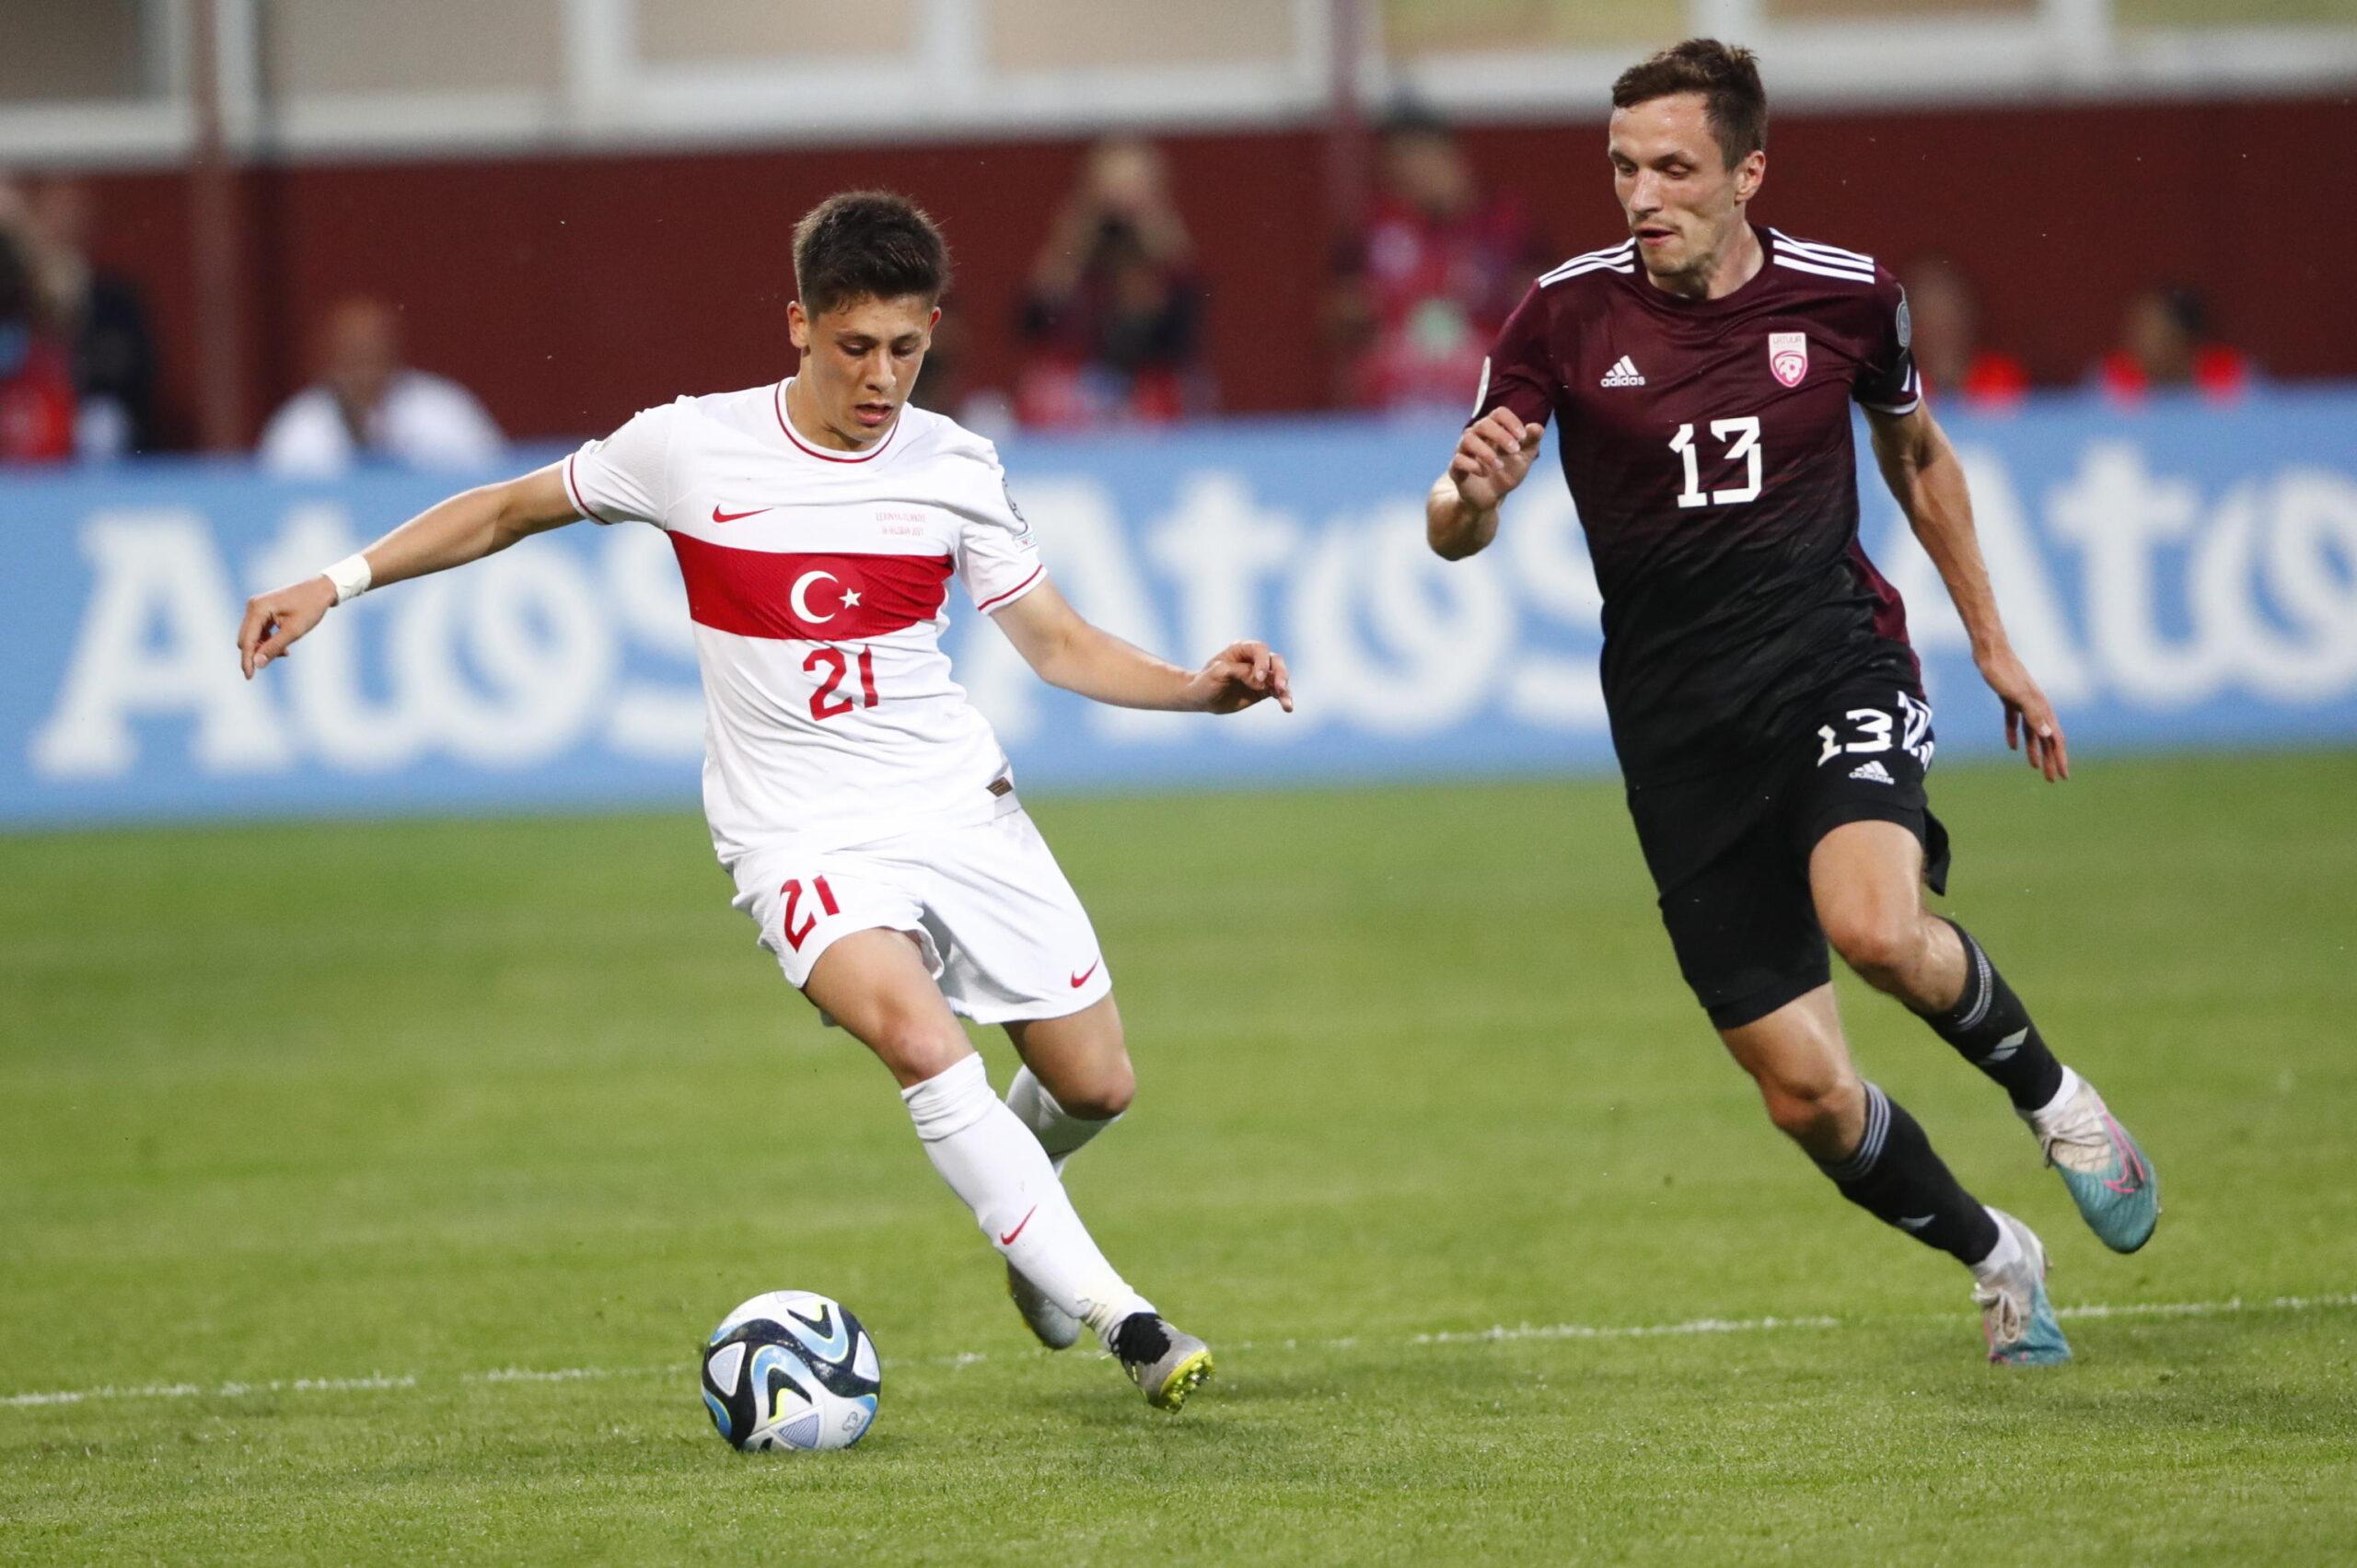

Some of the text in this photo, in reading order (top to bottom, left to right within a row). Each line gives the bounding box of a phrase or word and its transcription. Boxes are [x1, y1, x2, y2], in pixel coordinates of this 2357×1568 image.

[1600, 375, 1645, 388] adidas
[1668, 415, 1762, 508] 13
[803, 644, 879, 721] 21
[1817, 708, 1893, 768] 13
[780, 875, 840, 953] 21
